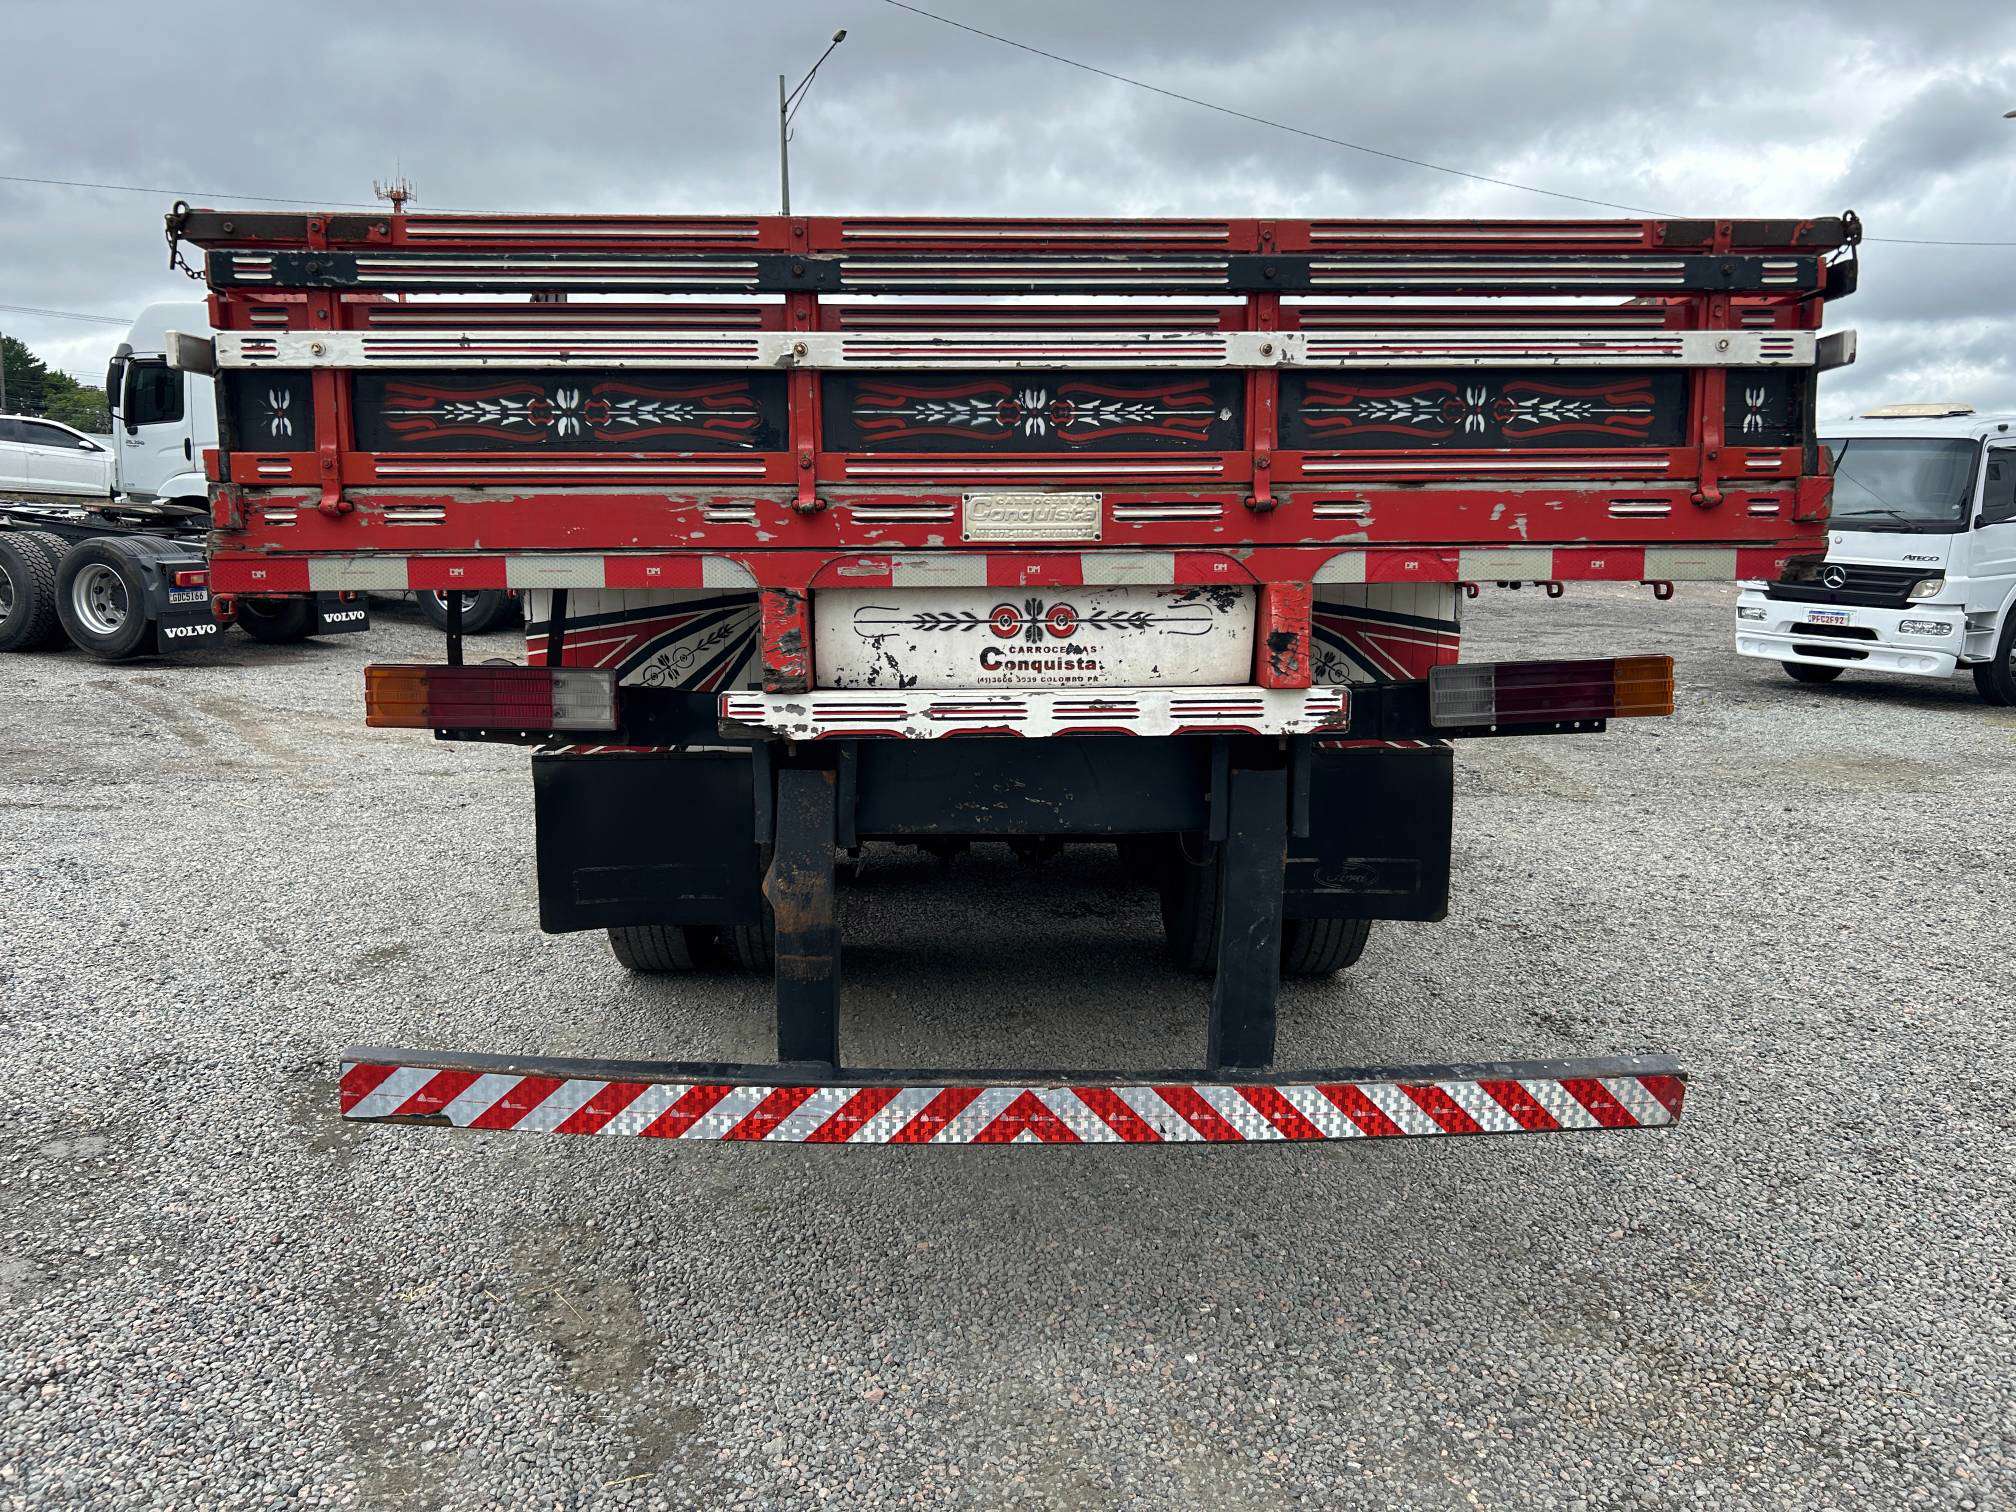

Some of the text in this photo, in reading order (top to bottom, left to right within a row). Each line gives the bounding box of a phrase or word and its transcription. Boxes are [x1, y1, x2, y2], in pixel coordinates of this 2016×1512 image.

[969, 496, 1096, 523] Conquista
[323, 610, 366, 623] VOLVO
[164, 624, 217, 639] VOLVO
[1008, 646, 1097, 655] CARROCEAS
[979, 646, 1097, 673] Conquista
